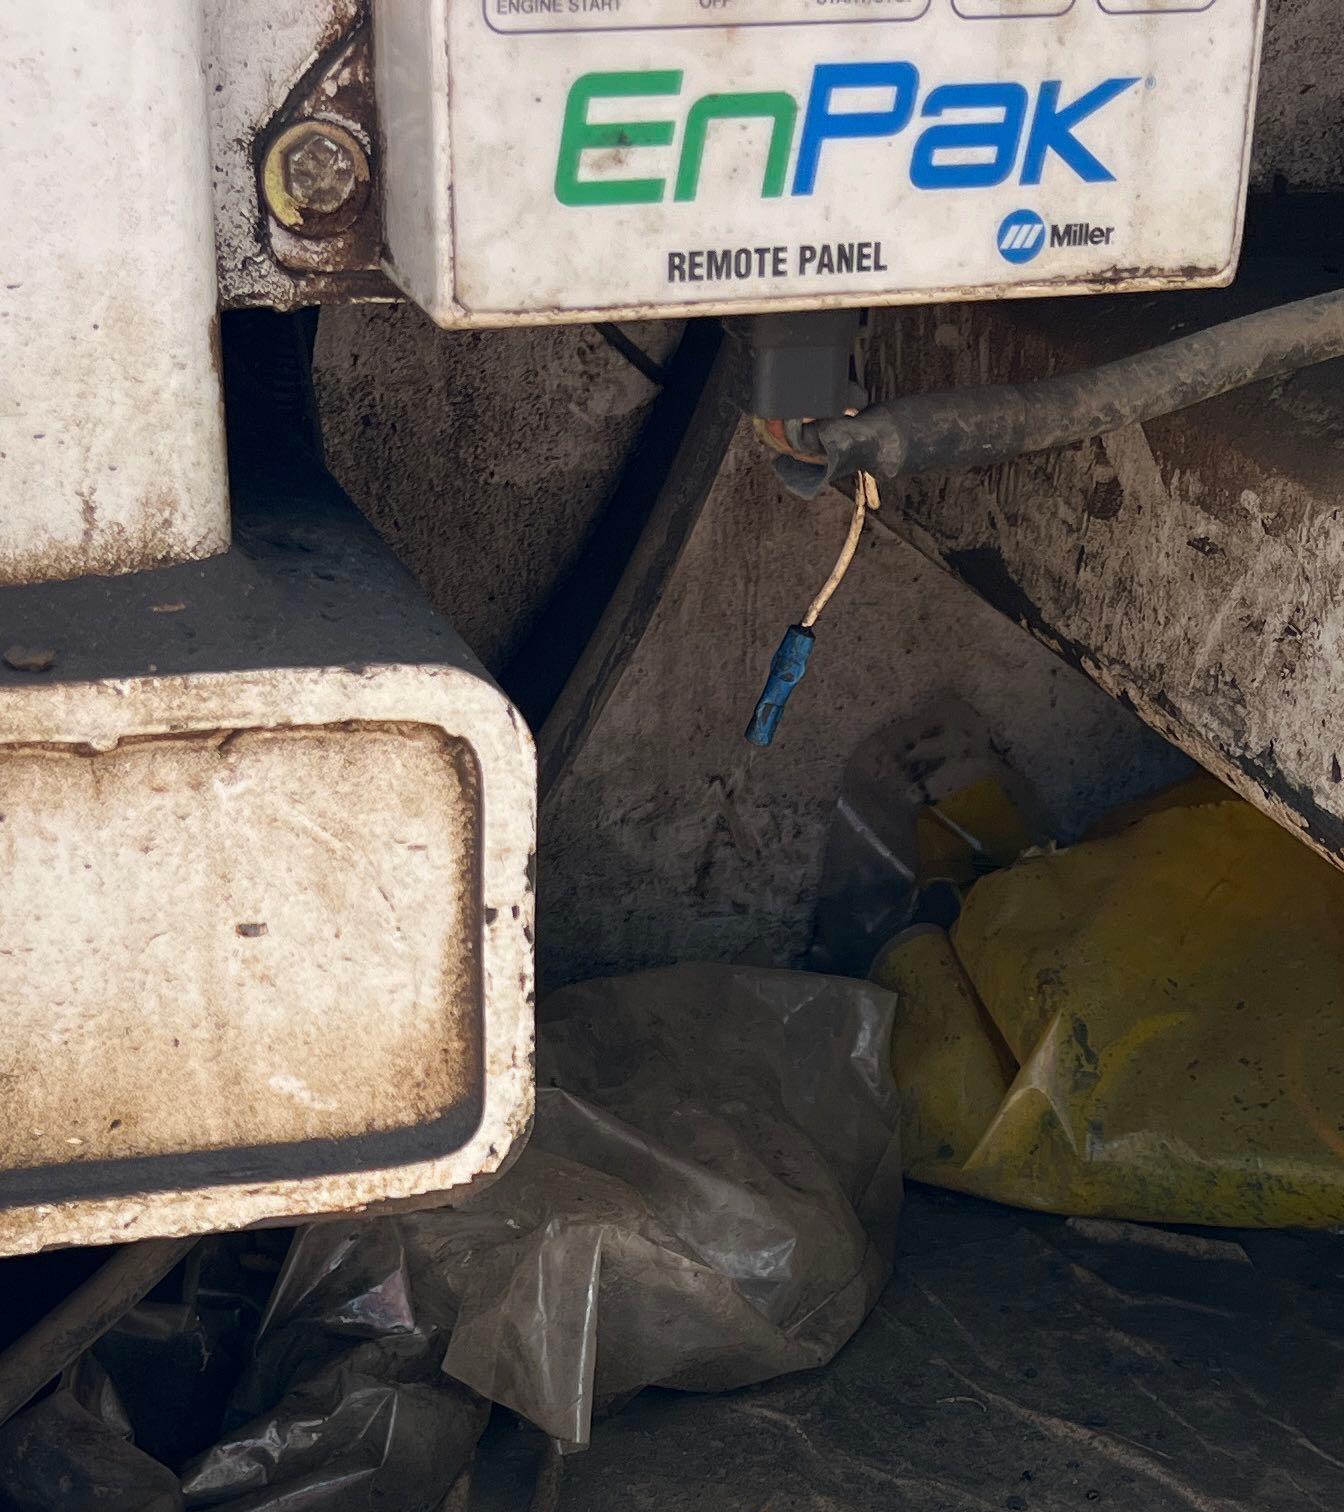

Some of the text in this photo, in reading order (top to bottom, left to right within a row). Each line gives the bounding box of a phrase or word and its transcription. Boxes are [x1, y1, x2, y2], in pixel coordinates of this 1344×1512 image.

[497, 0, 562, 14] ENGINE
[554, 61, 1143, 207] EnPak
[1050, 222, 1116, 249] Miller
[668, 241, 888, 283] REMOTE PANEL
